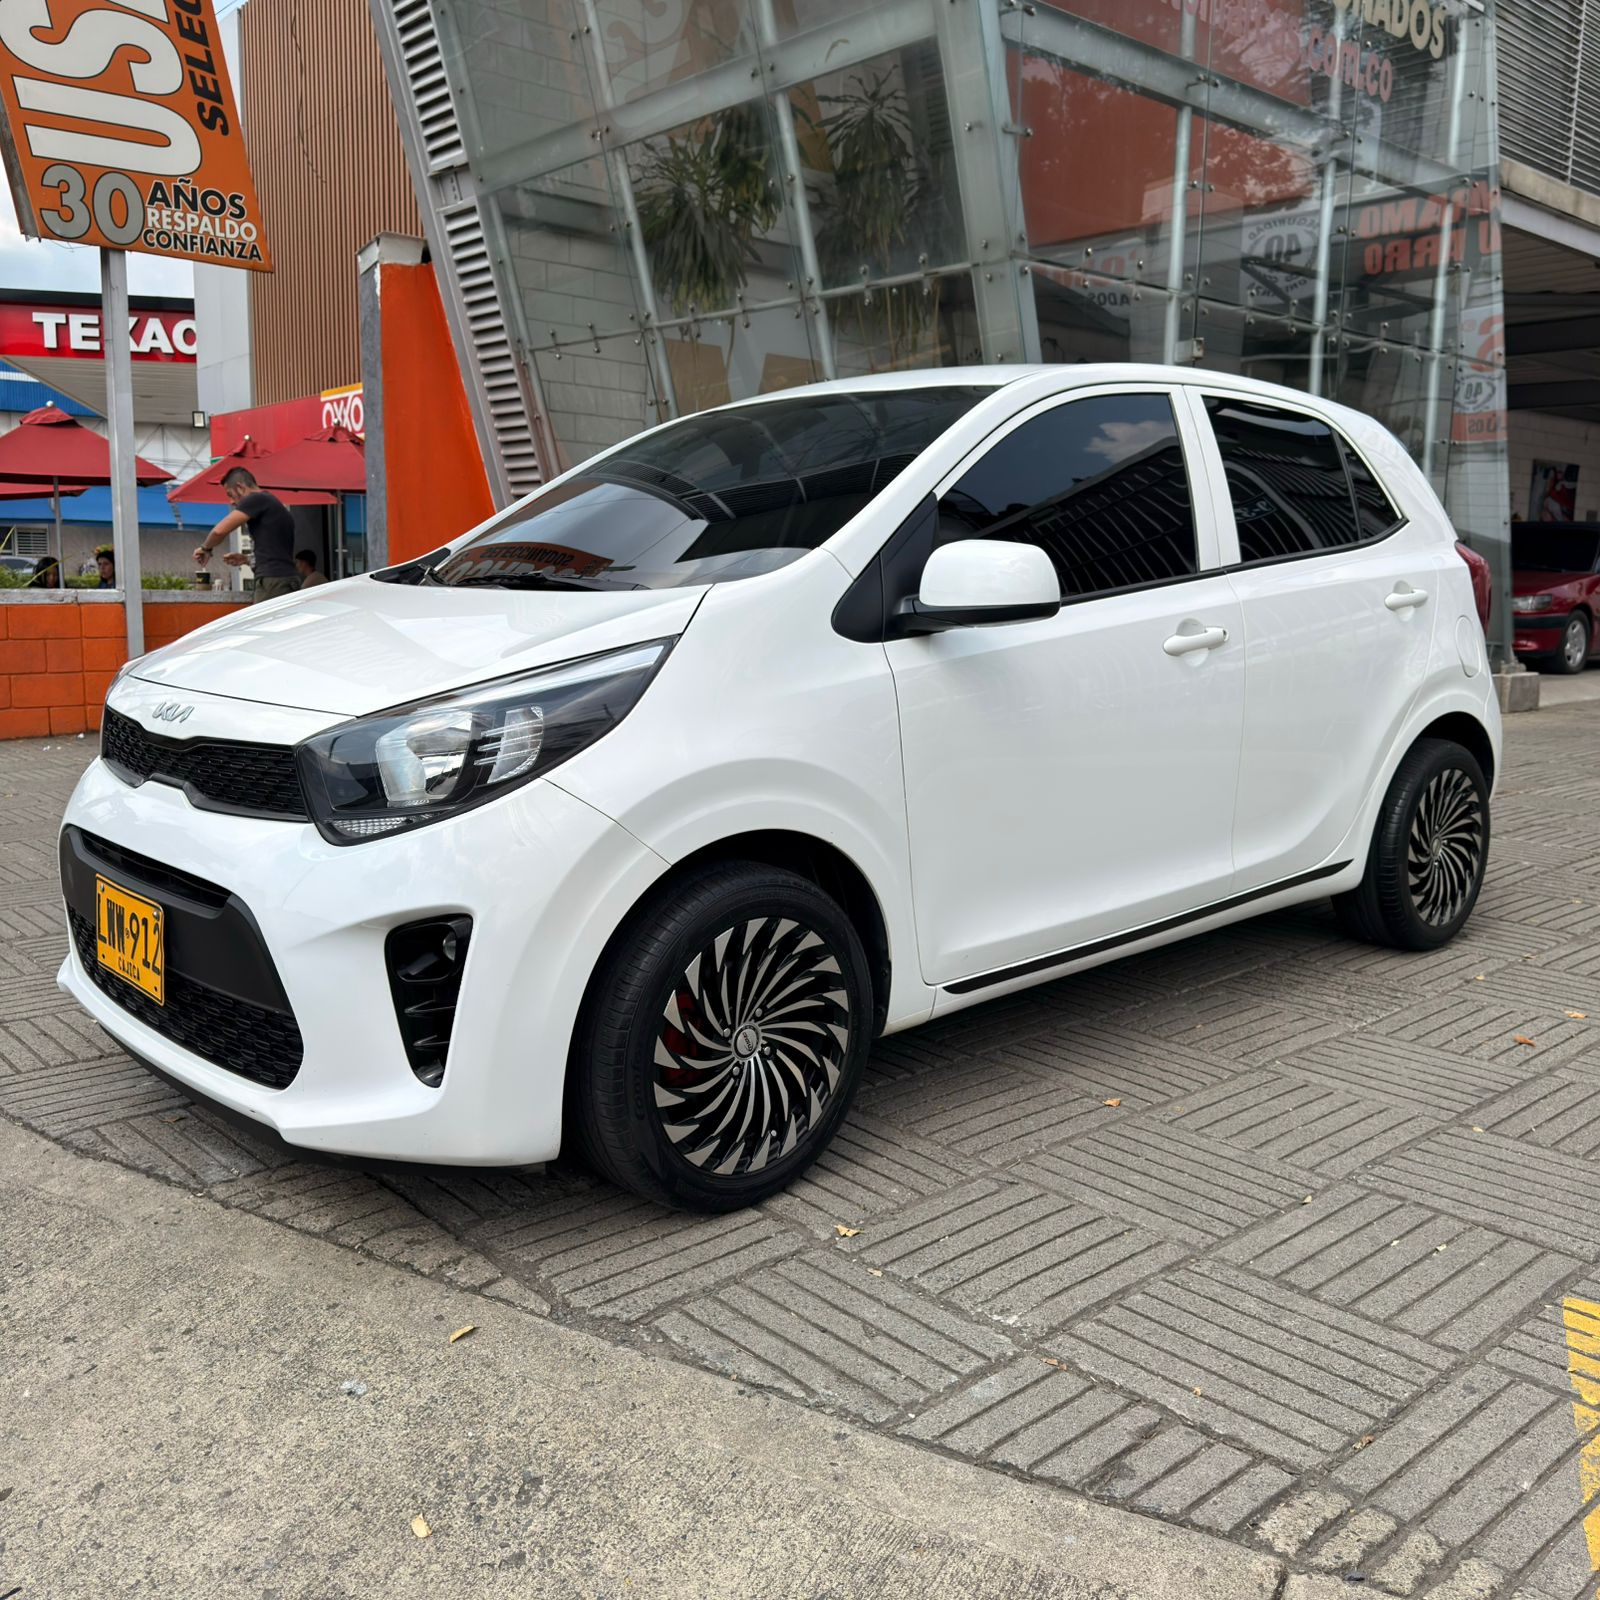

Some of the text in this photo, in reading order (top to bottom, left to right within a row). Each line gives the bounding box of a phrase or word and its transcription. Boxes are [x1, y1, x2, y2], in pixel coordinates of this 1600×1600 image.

[0, 0, 202, 176] US
[40, 164, 145, 246] 30
[146, 177, 247, 220] AÑOS
[146, 208, 257, 241] RESPALDO
[142, 228, 263, 262] CONFIANZA
[322, 394, 364, 433] OXXO
[151, 701, 195, 723] KIA
